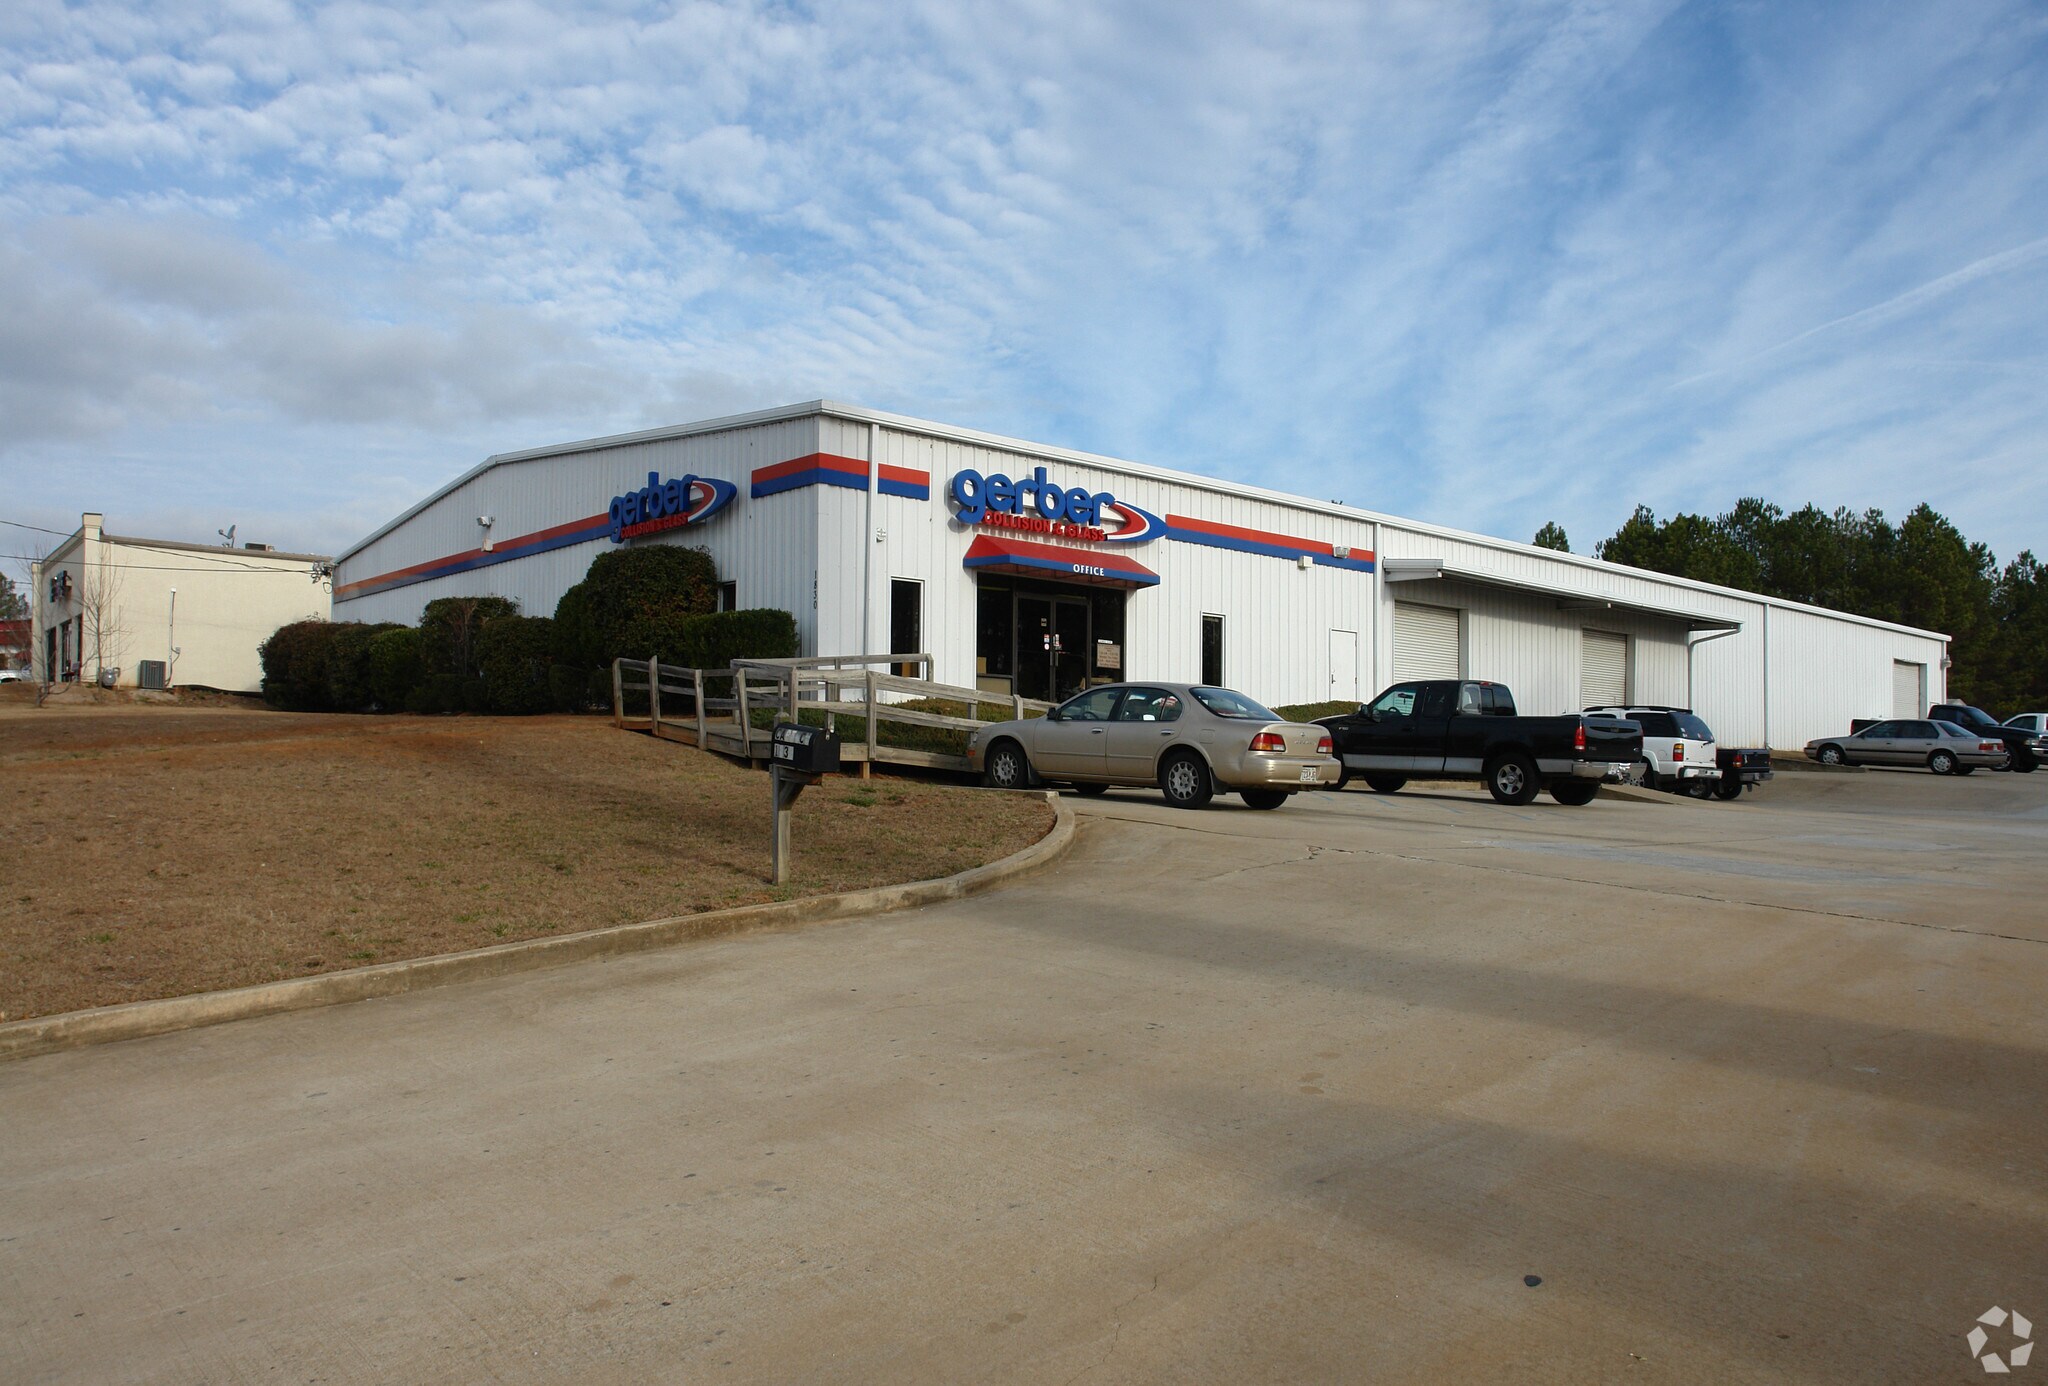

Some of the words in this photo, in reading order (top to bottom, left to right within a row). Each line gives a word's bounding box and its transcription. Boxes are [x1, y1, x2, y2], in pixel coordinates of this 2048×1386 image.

[609, 471, 699, 544] gerber
[951, 466, 1117, 525] gerber
[621, 520, 655, 538] COLLISION
[663, 511, 689, 529] GLASS
[984, 510, 1050, 533] COLLISION
[1052, 521, 1063, 536] &
[1065, 523, 1105, 541] GLASS
[1073, 563, 1105, 577] OFFICE
